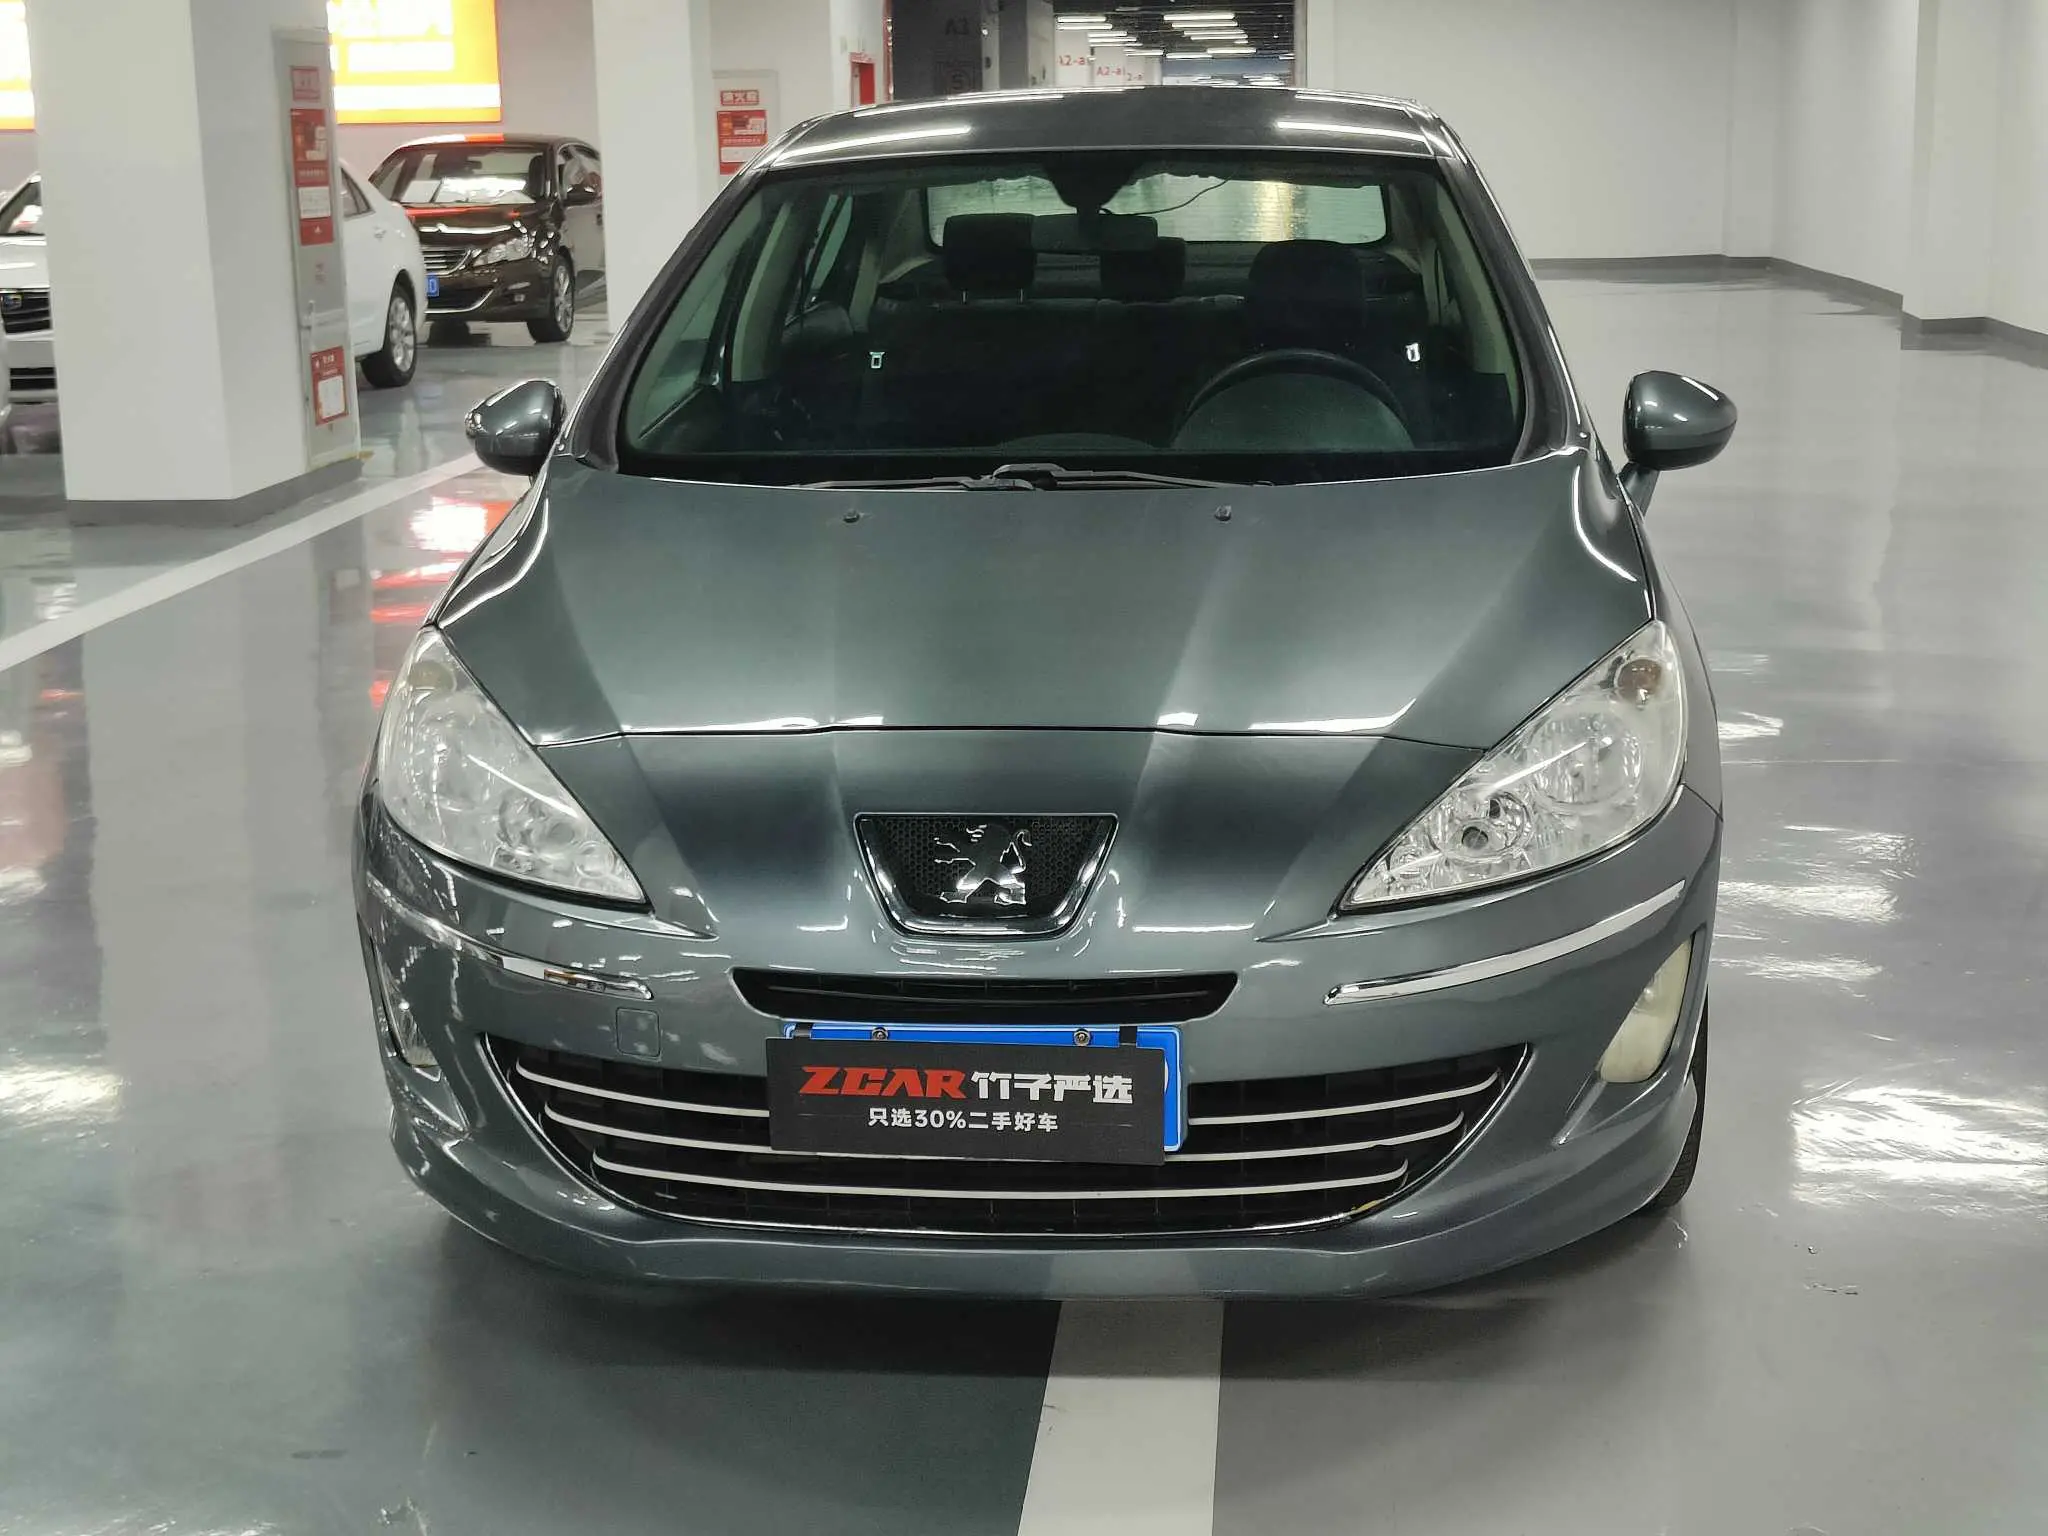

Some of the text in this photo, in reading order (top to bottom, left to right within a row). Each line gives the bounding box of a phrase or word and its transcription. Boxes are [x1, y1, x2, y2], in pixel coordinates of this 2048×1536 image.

[799, 1066, 1134, 1104] ZCAR 竹子严选
[868, 1107, 1059, 1132] 只选30%二手好车
